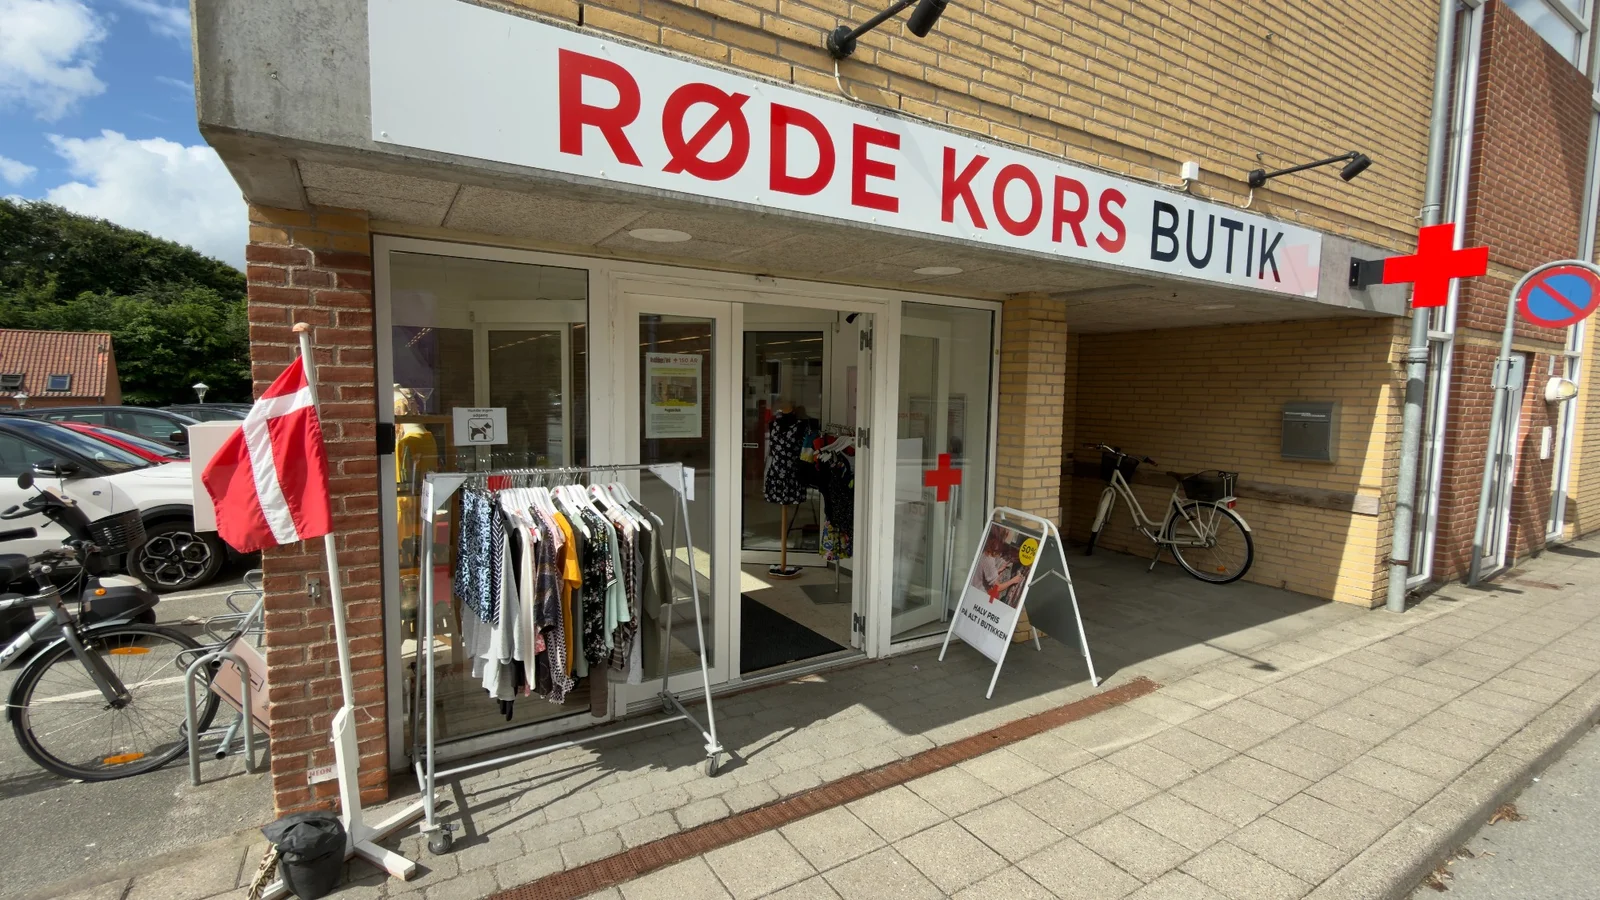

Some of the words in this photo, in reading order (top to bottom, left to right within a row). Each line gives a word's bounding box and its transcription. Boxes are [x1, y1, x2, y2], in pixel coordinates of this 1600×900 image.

[558, 47, 901, 214] RØDE
[940, 146, 1128, 254] KORS
[1150, 200, 1285, 283] BUTIK
[1021, 544, 1036, 556] 50%
[973, 604, 987, 616] HALV
[987, 612, 1000, 624] PRIS
[968, 613, 979, 622] ALT
[980, 619, 1008, 641] BUTIKKEN
